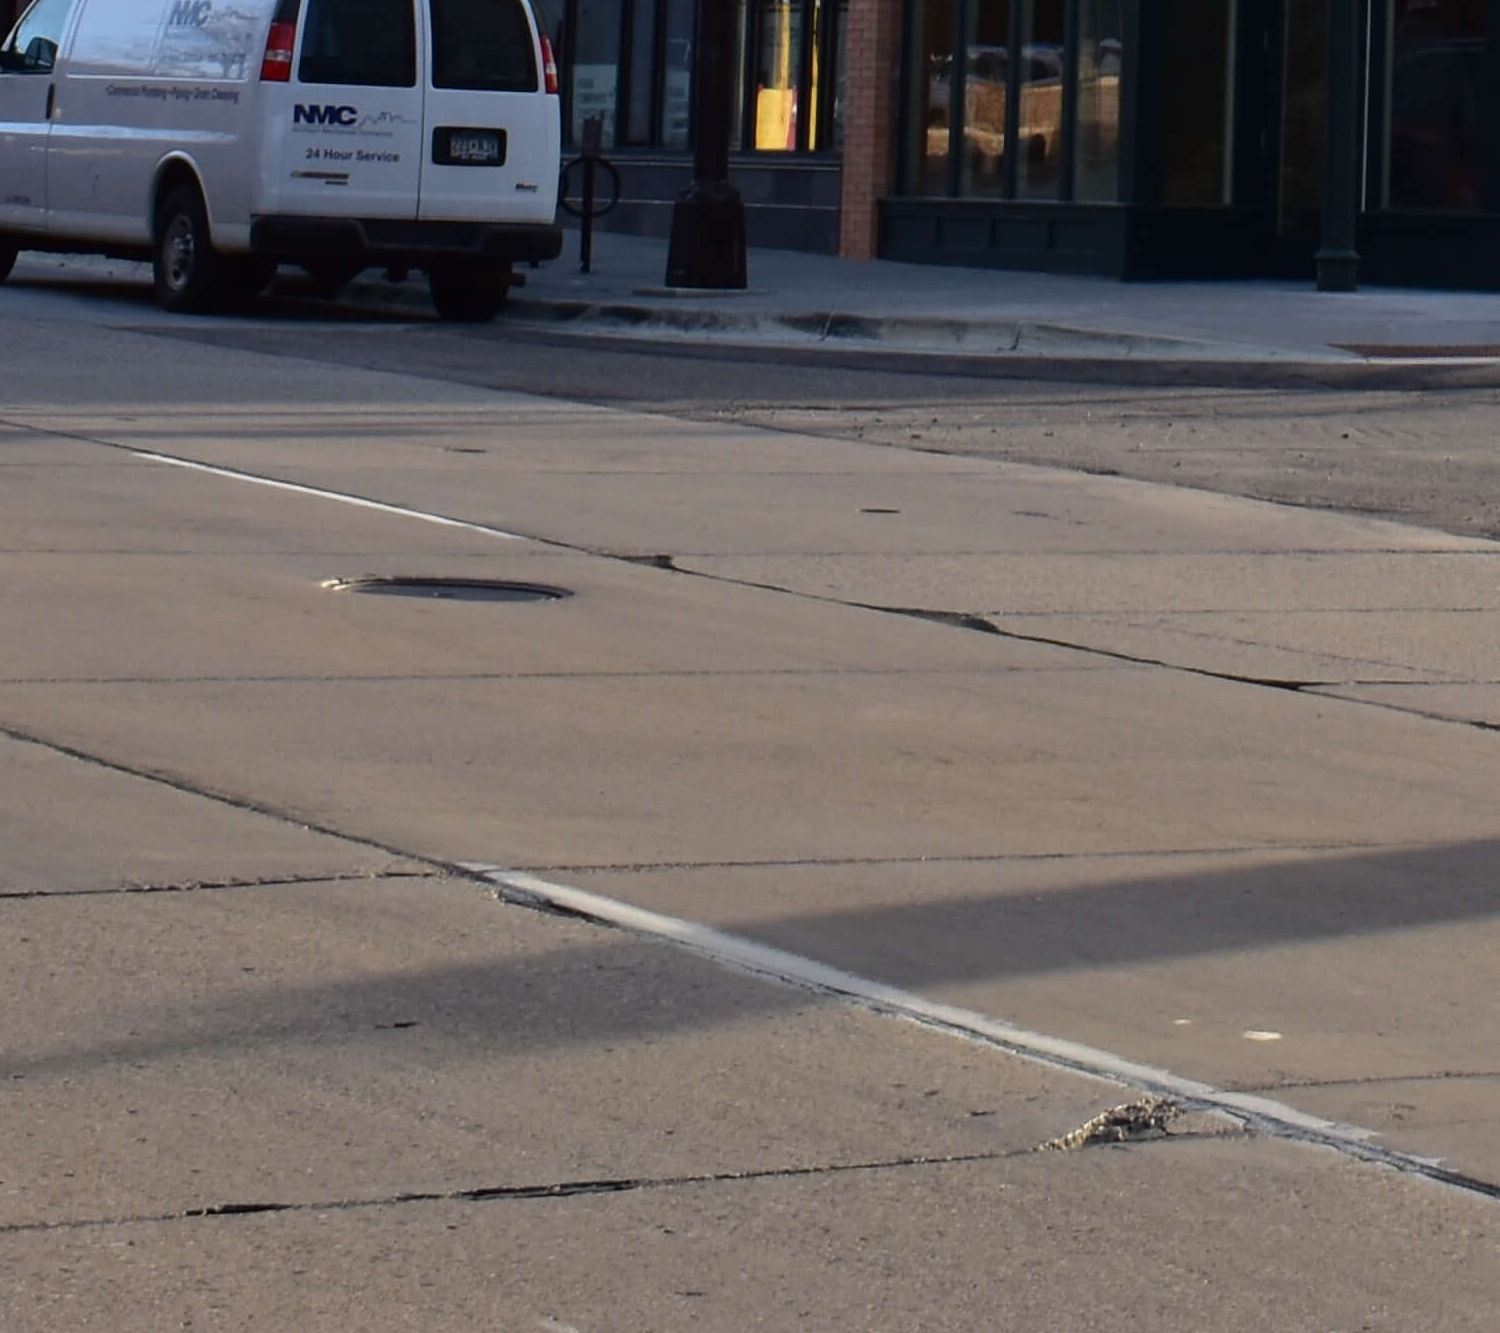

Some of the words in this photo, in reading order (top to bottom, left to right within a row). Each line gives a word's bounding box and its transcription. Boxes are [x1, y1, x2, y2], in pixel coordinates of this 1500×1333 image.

[294, 103, 357, 126] NMC
[305, 148, 320, 160] 24
[324, 149, 352, 161] Hour
[356, 150, 400, 163] Service
